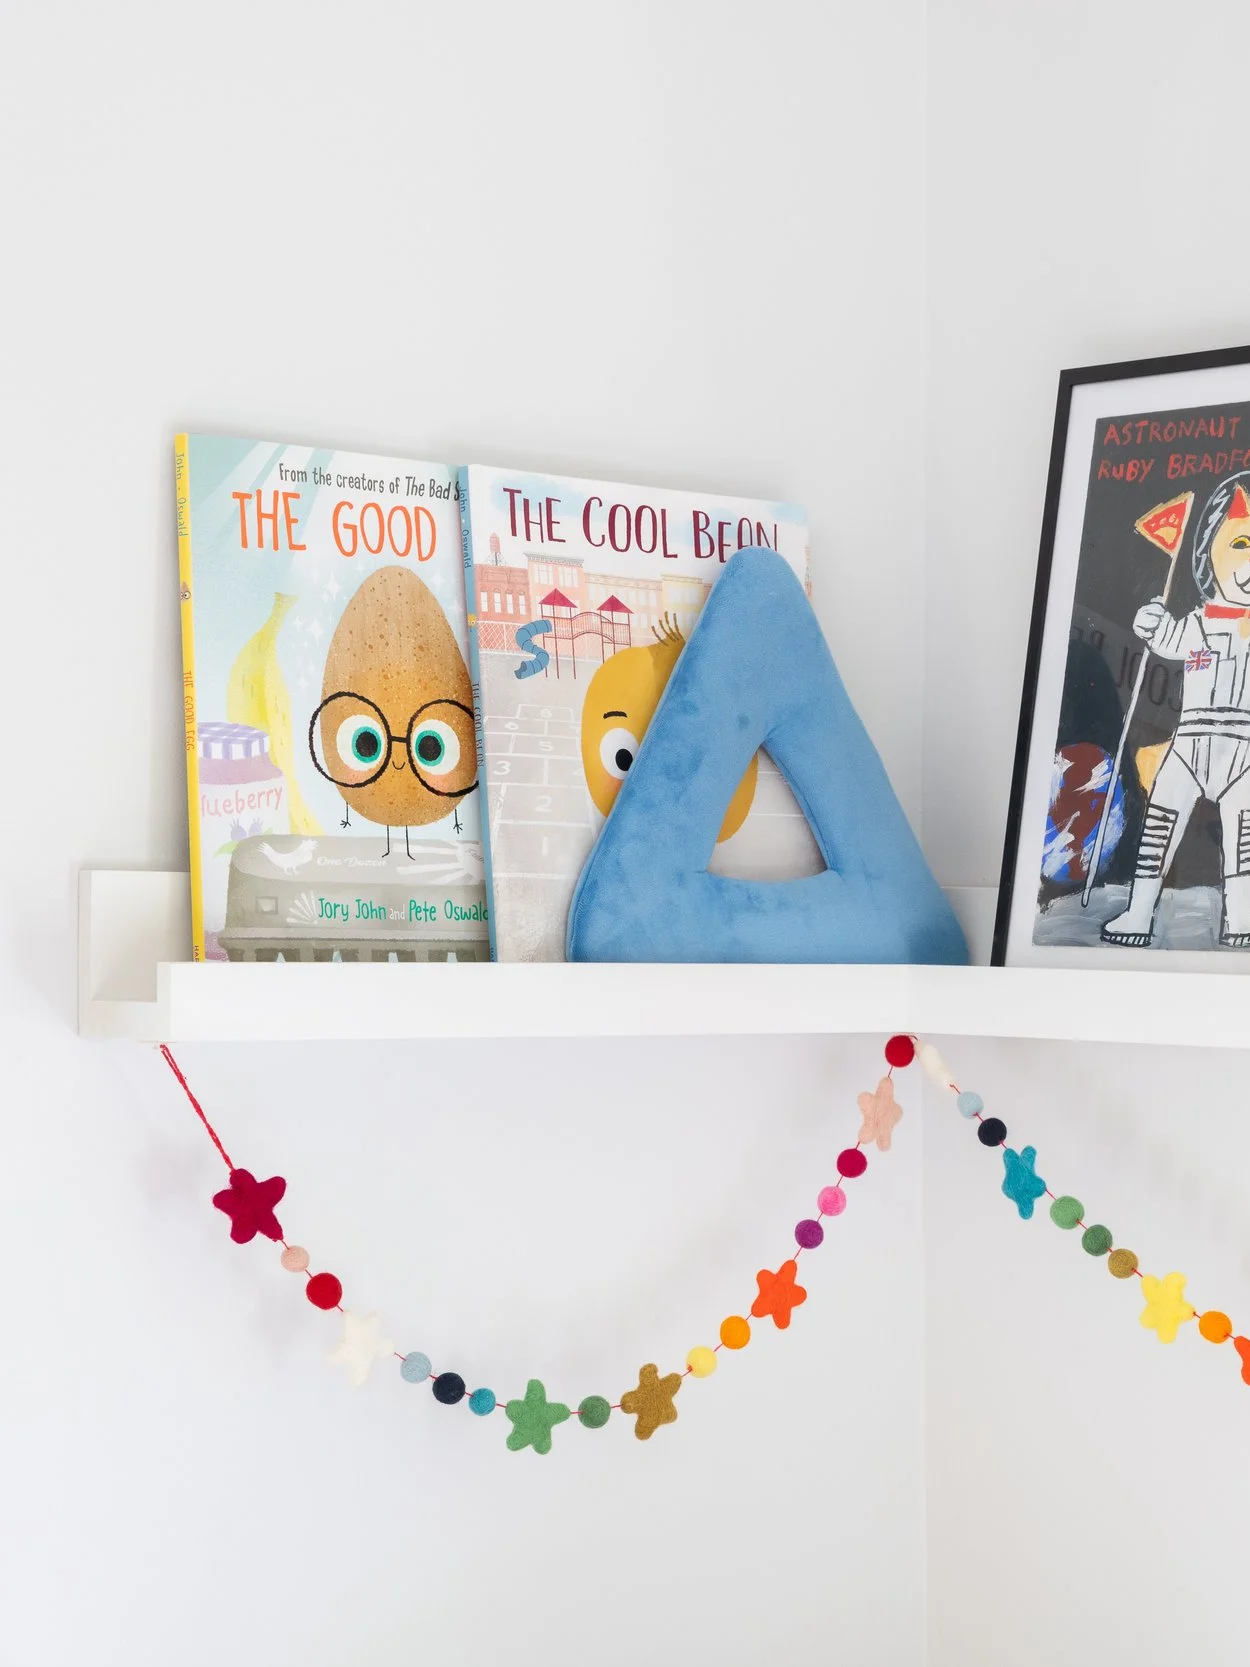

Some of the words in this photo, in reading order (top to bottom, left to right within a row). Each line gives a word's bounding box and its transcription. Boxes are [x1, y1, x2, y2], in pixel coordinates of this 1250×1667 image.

[1103, 416, 1242, 446] ASTRONAUT
[176, 453, 185, 480] John
[279, 463, 308, 482] From
[312, 467, 332, 486] the
[336, 473, 384, 494] creators
[389, 477, 400, 494] of
[405, 476, 425, 497] The
[429, 478, 451, 500] Bad
[460, 487, 468, 512] John
[177, 497, 189, 537] Oswald
[232, 488, 307, 551] THE
[332, 500, 436, 562] GOOD
[502, 487, 566, 543] THE
[582, 496, 678, 558] COOL
[692, 510, 777, 563] BEAN
[462, 530, 472, 568] Oswald
[184, 670, 194, 688] THE
[184, 696, 194, 724] GOOD
[186, 730, 196, 752] EGG
[539, 741, 554, 752] 5
[493, 760, 511, 776] 3
[534, 796, 552, 812] 2
[318, 897, 349, 922] Jory
[355, 898, 387, 920] John
[390, 904, 406, 920] and
[409, 899, 437, 922] Pete
